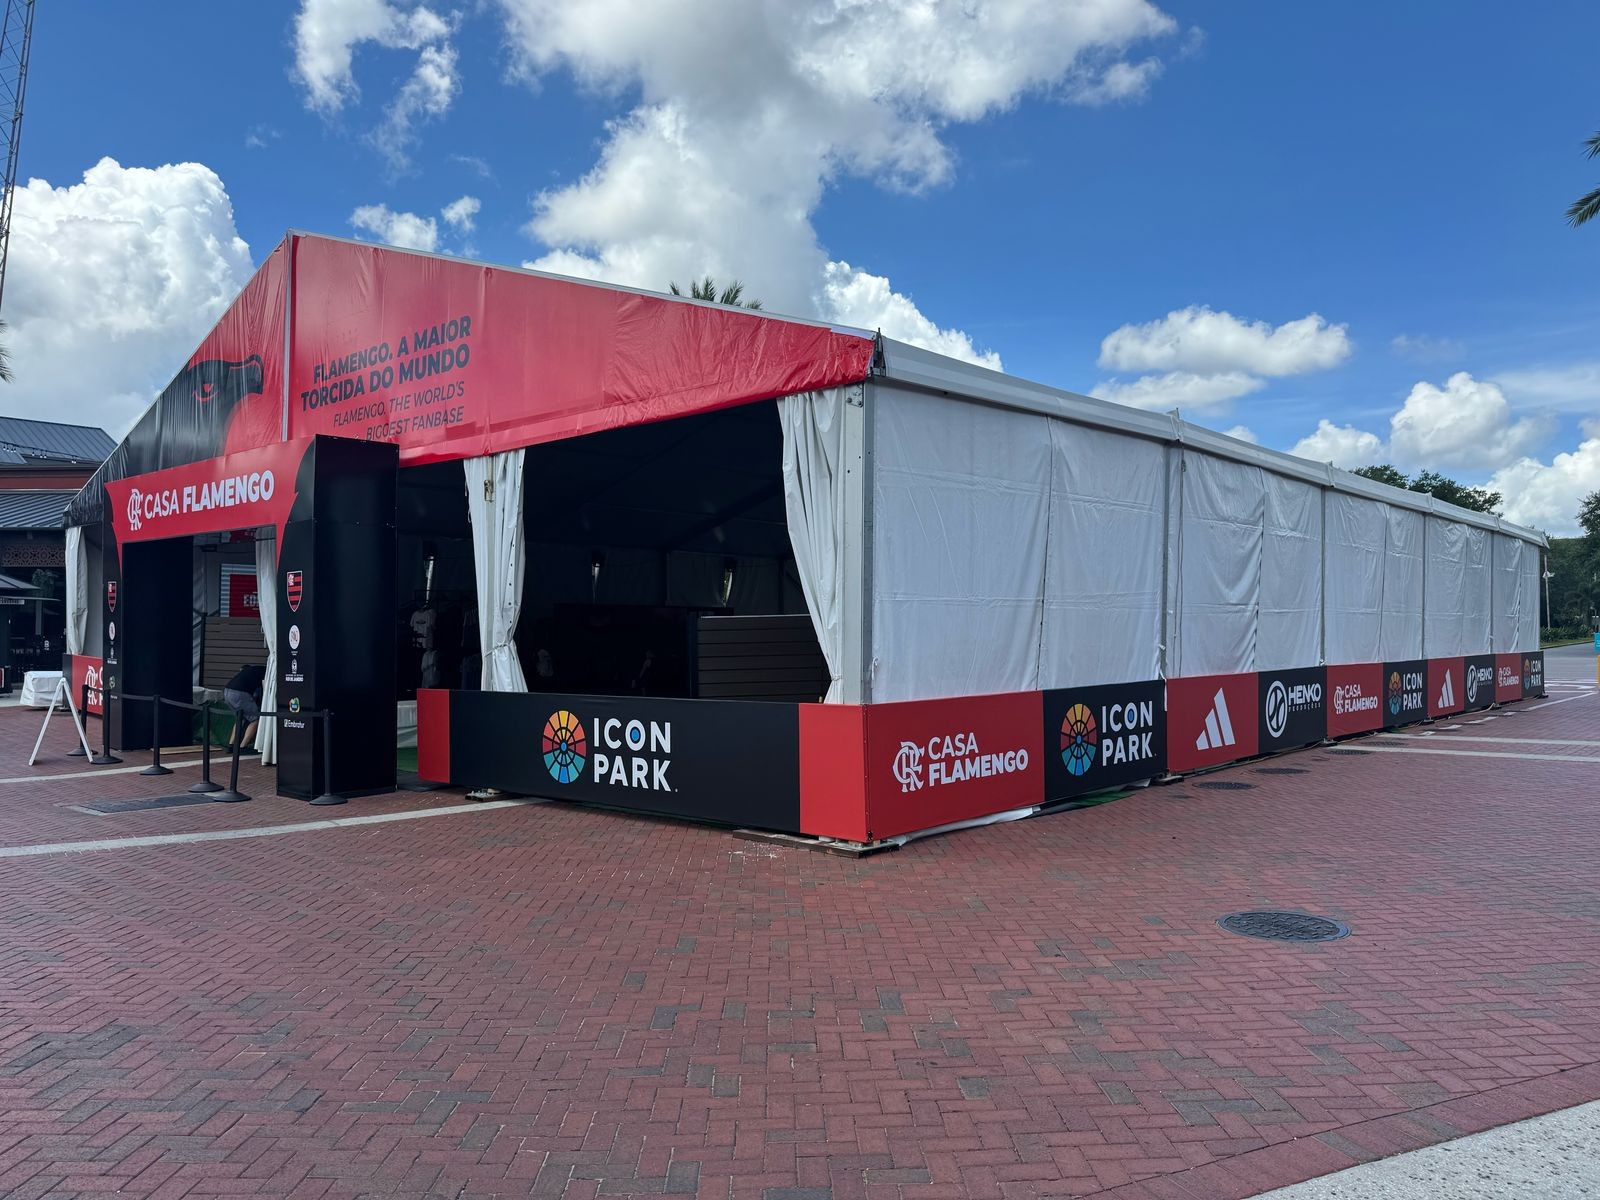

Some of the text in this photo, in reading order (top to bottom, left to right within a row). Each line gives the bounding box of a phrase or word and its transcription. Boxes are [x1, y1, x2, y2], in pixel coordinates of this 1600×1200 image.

[397, 336, 409, 358] A
[414, 316, 471, 352] MAIOR
[301, 344, 470, 412] TORCIDA DO MUNDO
[389, 394, 411, 413] THE
[413, 381, 465, 407] WORLD'S
[366, 406, 464, 441] BIGGEST FANBASE
[144, 489, 180, 519] CASA
[183, 470, 274, 514] FLAMENGO
[1530, 659, 1541, 672] ICON
[1530, 674, 1542, 687] PARK
[1288, 683, 1322, 705] HENKO
[1344, 684, 1362, 698] CASA
[1403, 672, 1423, 691] ICON
[1344, 696, 1378, 712] FLAMENGO
[1403, 691, 1423, 711] PARK
[1101, 700, 1153, 733] ICON
[593, 717, 671, 754] ICON
[928, 732, 979, 760] CASA
[928, 748, 1029, 787] FLAMENGO
